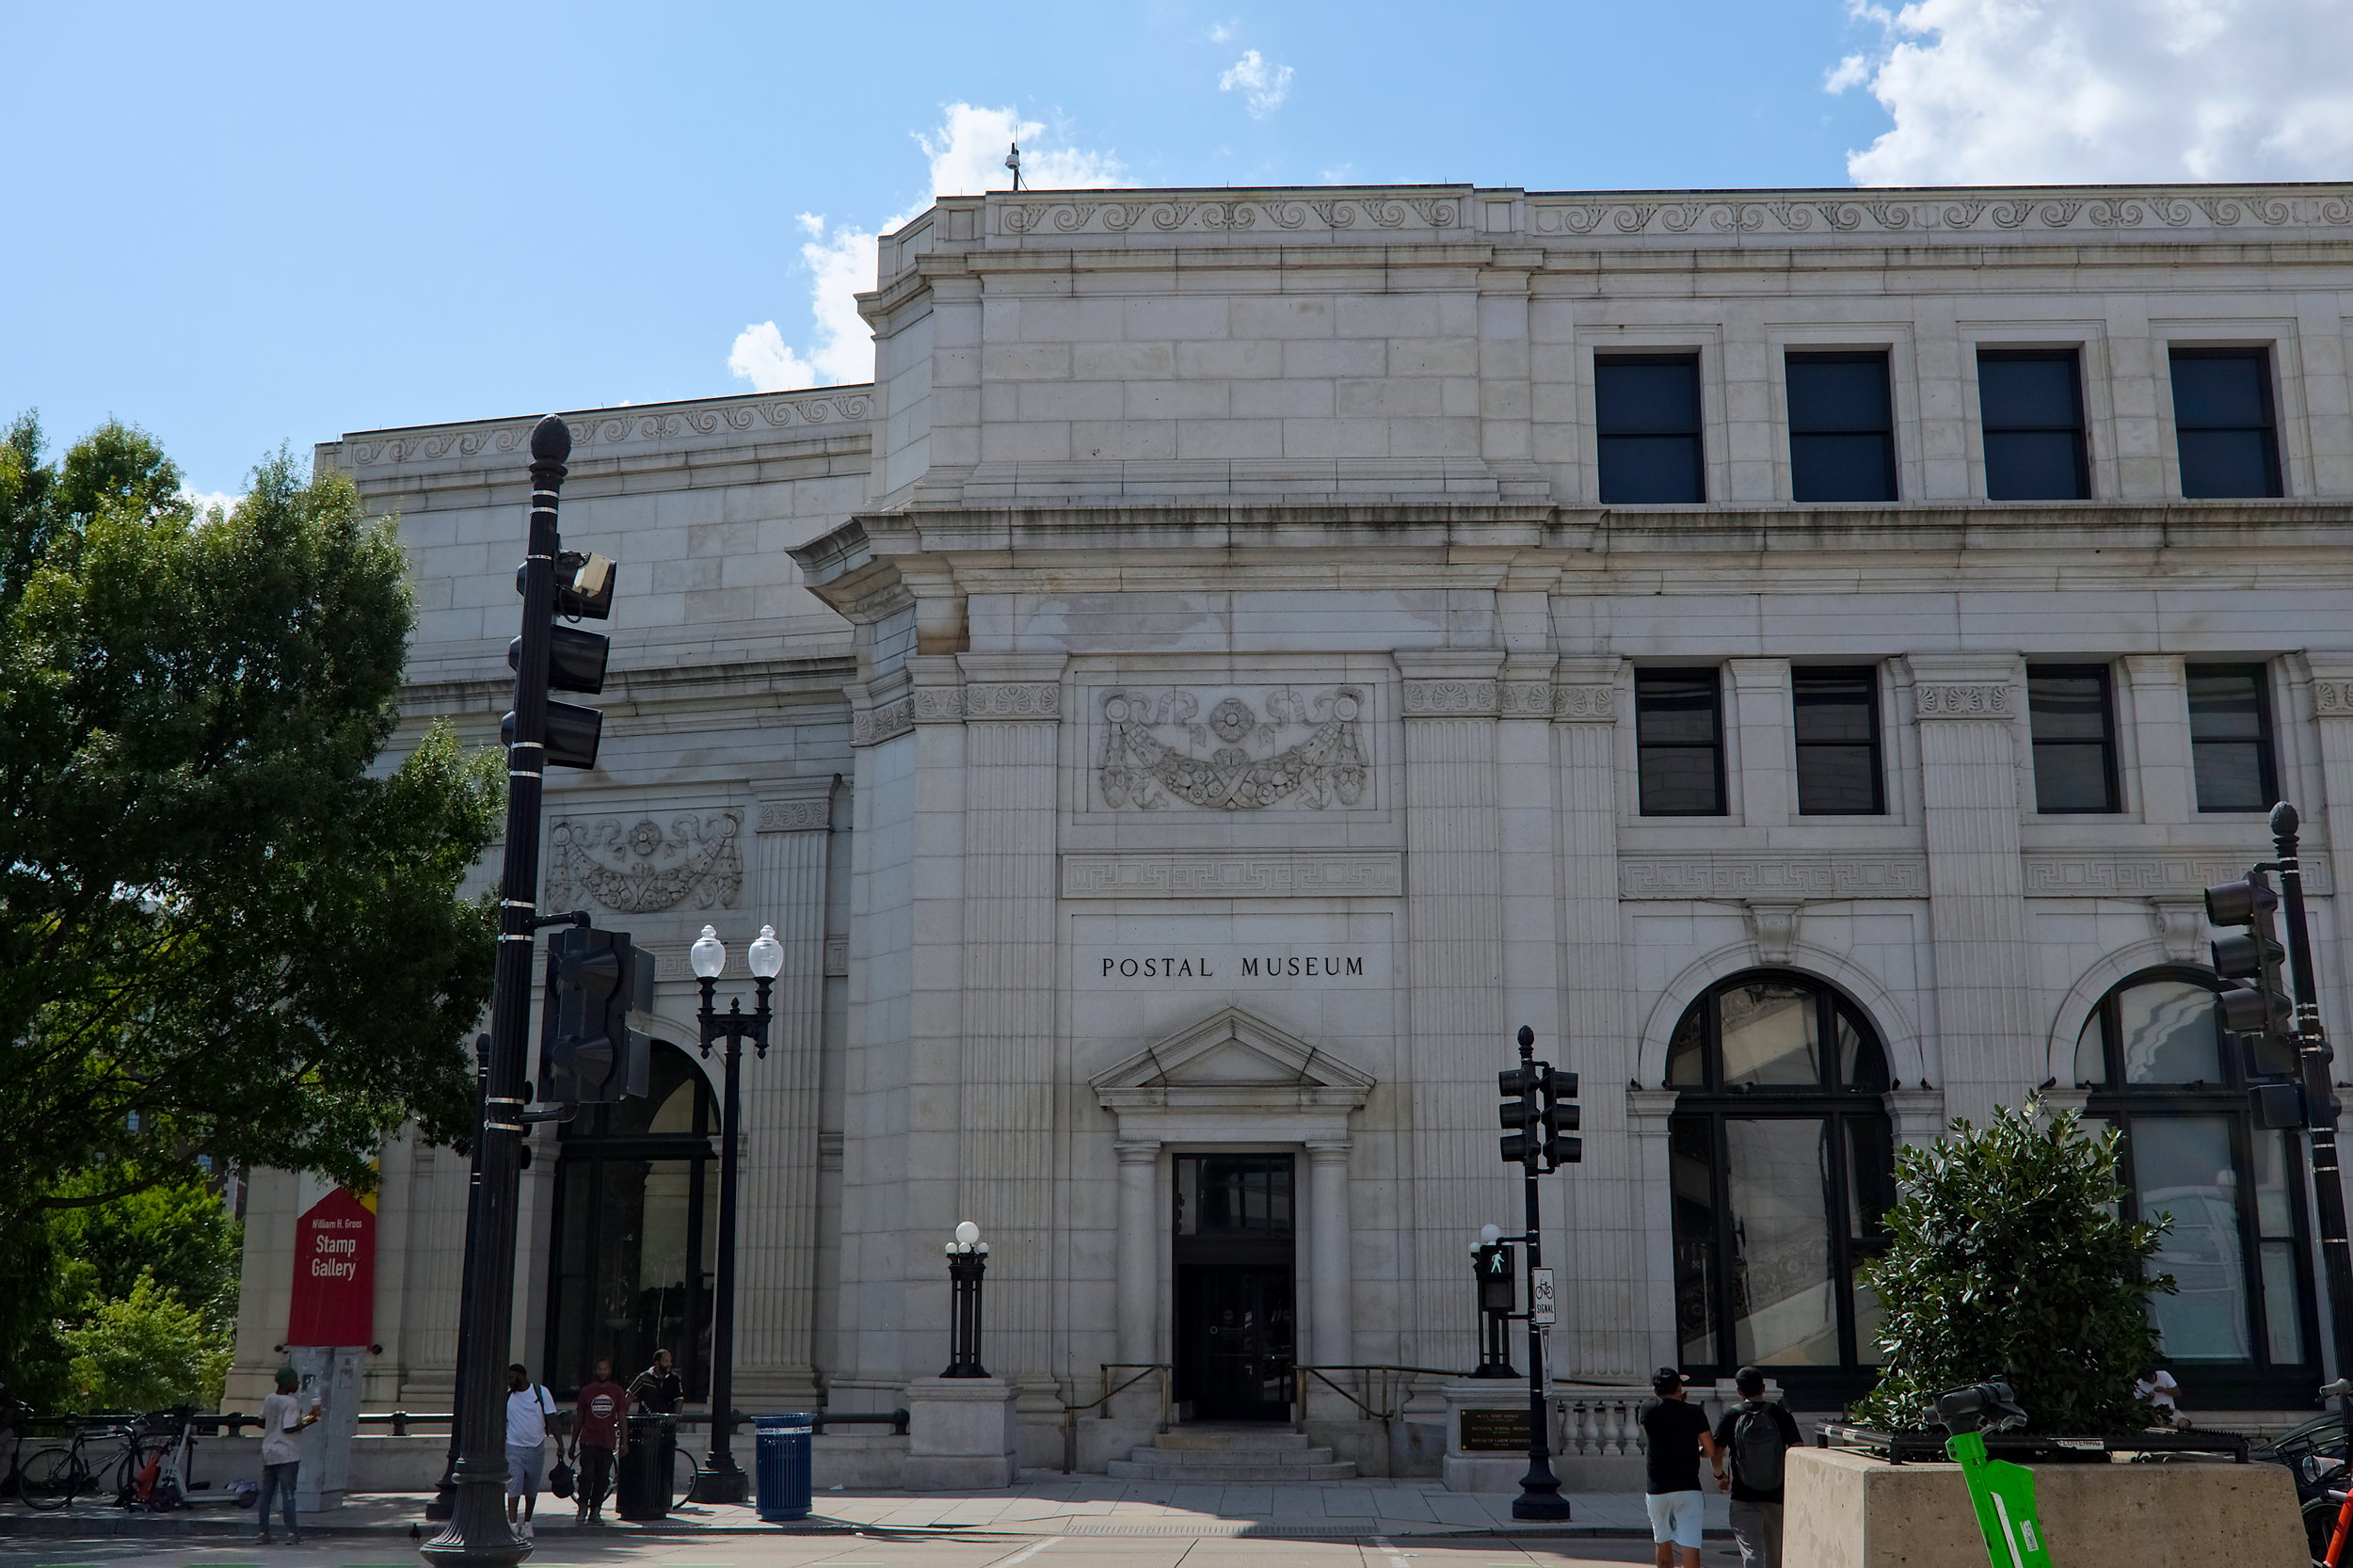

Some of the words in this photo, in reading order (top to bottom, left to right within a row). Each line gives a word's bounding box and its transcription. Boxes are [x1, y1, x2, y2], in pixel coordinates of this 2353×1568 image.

[1102, 957, 1213, 977] POSTAL
[1241, 956, 1364, 976] MUSEUM
[312, 1219, 336, 1229] William
[337, 1219, 344, 1228] H.
[344, 1218, 362, 1229] Gross
[315, 1234, 357, 1258] Stamp
[312, 1257, 357, 1282] Gallery
[1536, 1304, 1554, 1314] SIGNAL
